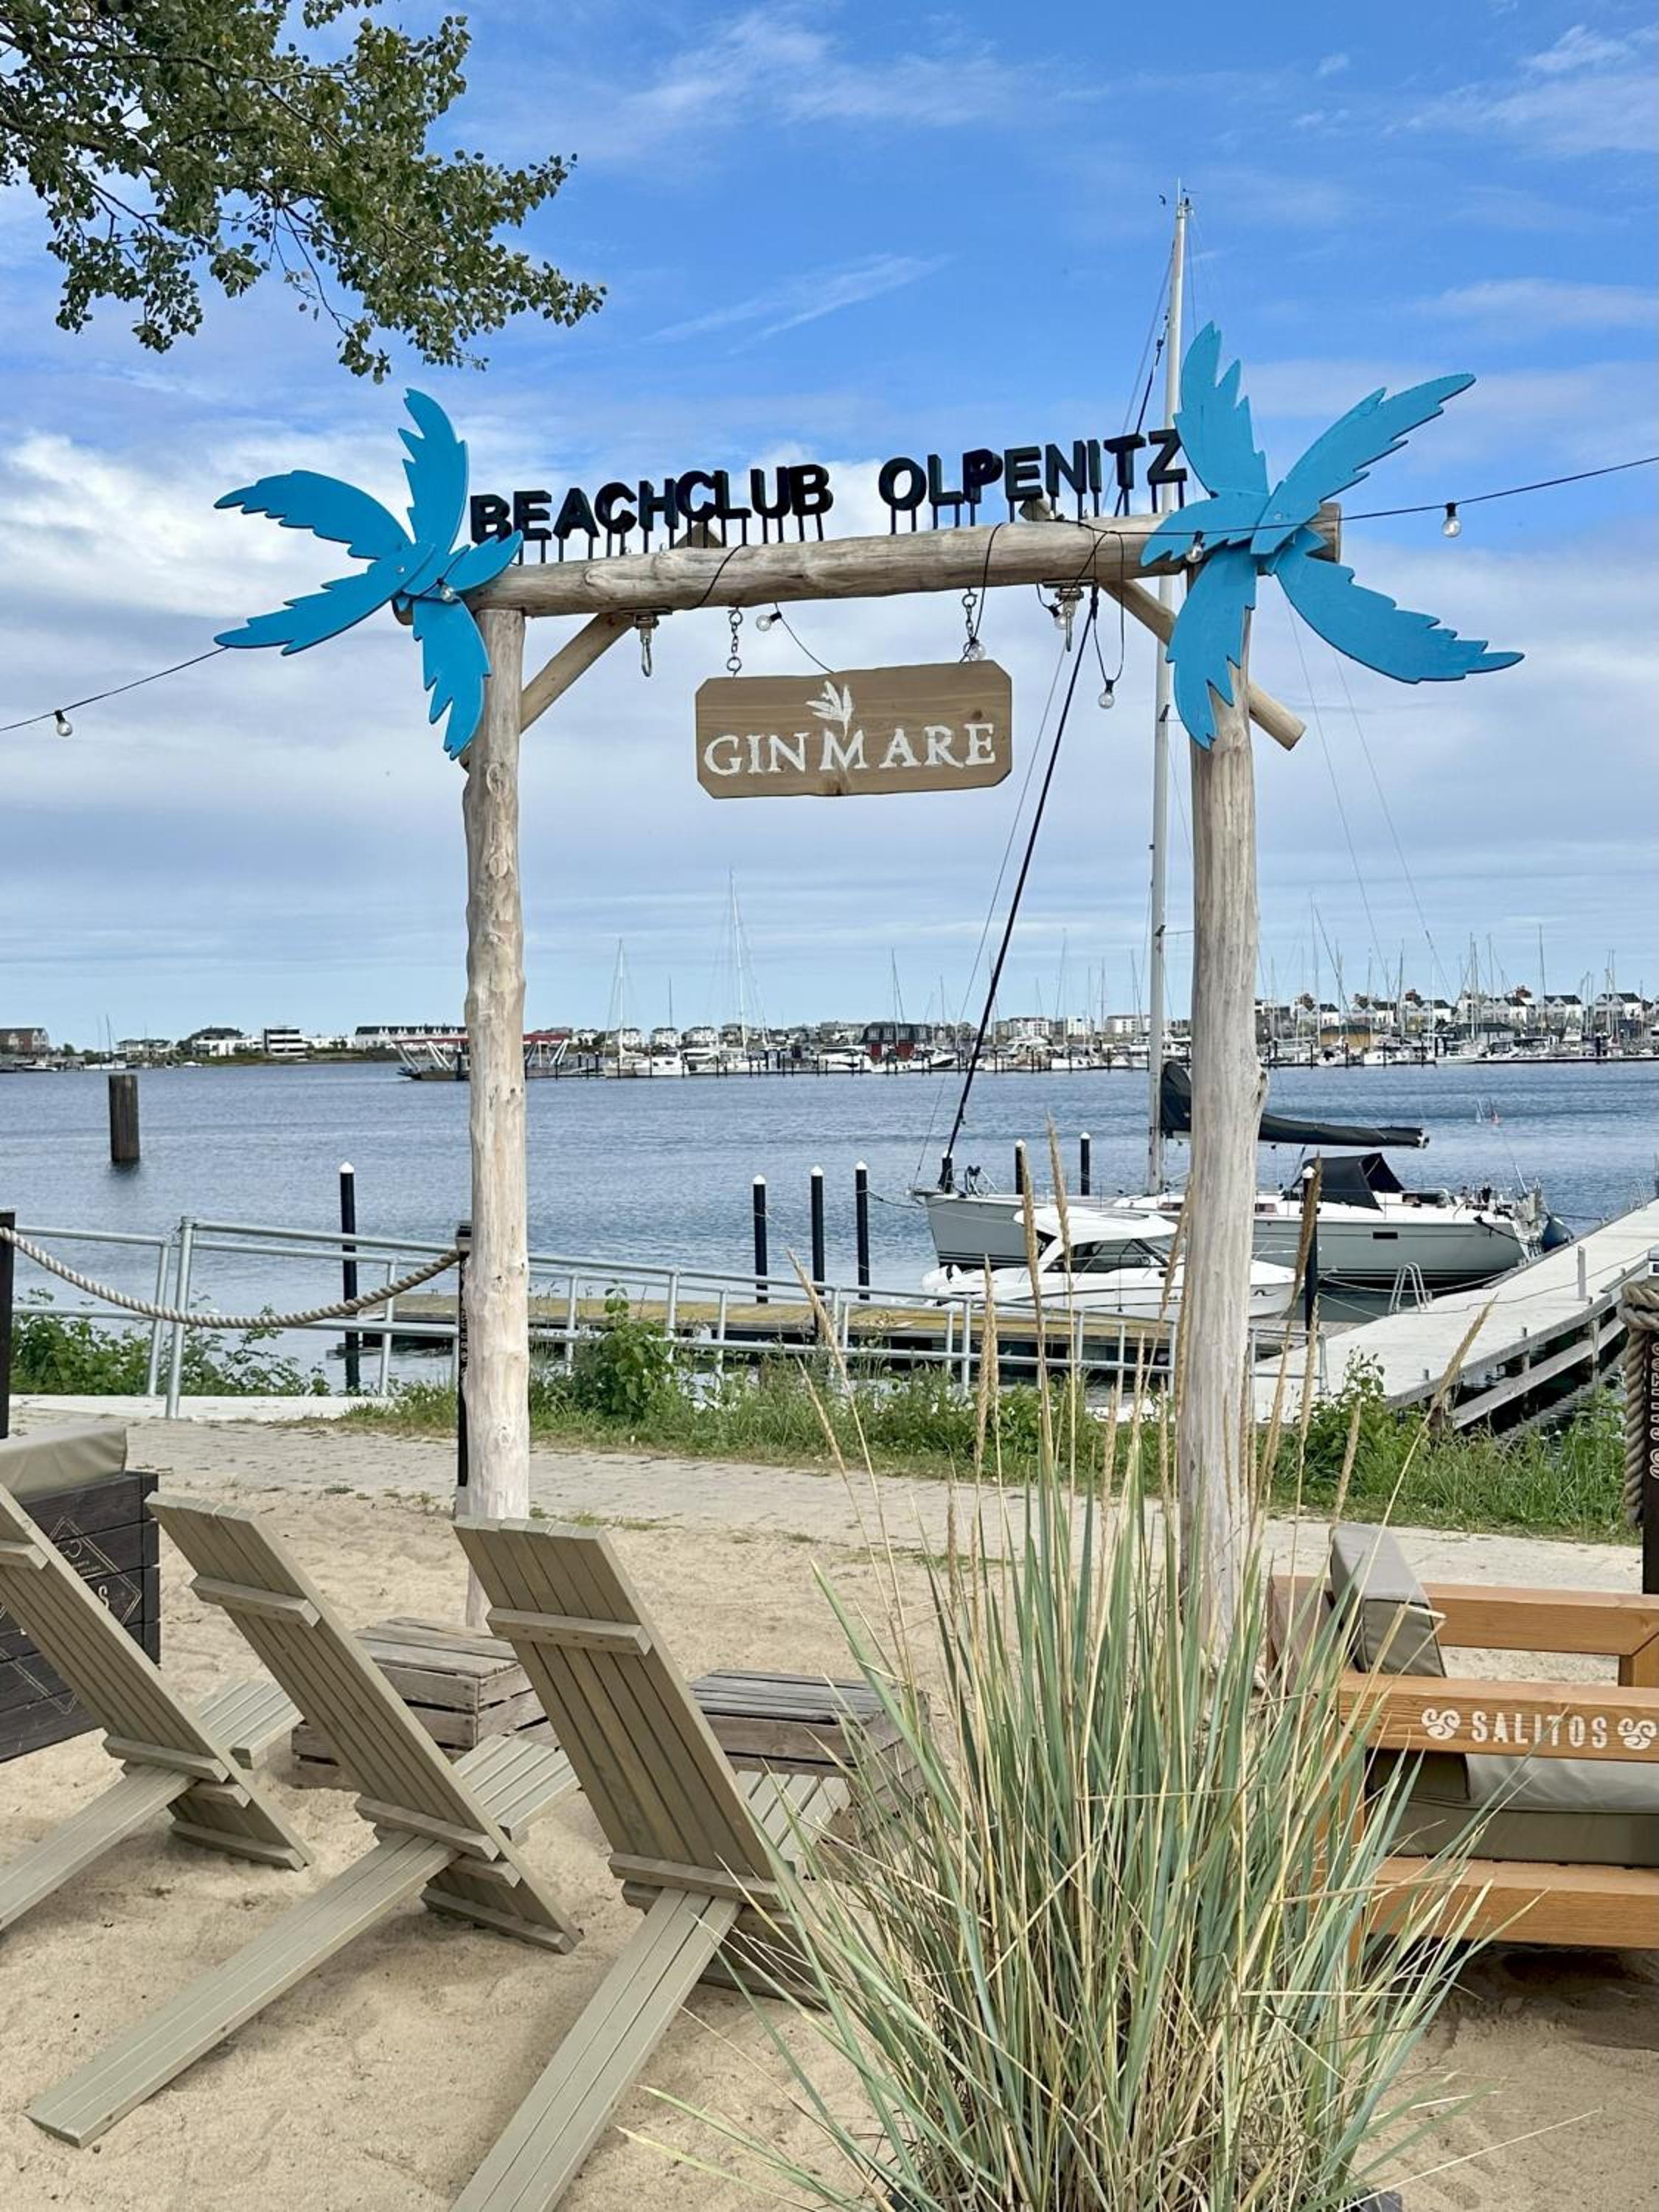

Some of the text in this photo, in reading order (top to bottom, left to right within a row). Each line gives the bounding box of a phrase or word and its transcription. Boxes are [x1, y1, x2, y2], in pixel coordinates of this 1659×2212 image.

[470, 428, 1188, 543] BEACHCLUB OLPENITZ
[704, 731, 811, 776] GIN
[1471, 1710, 1608, 1749] SALITOS
